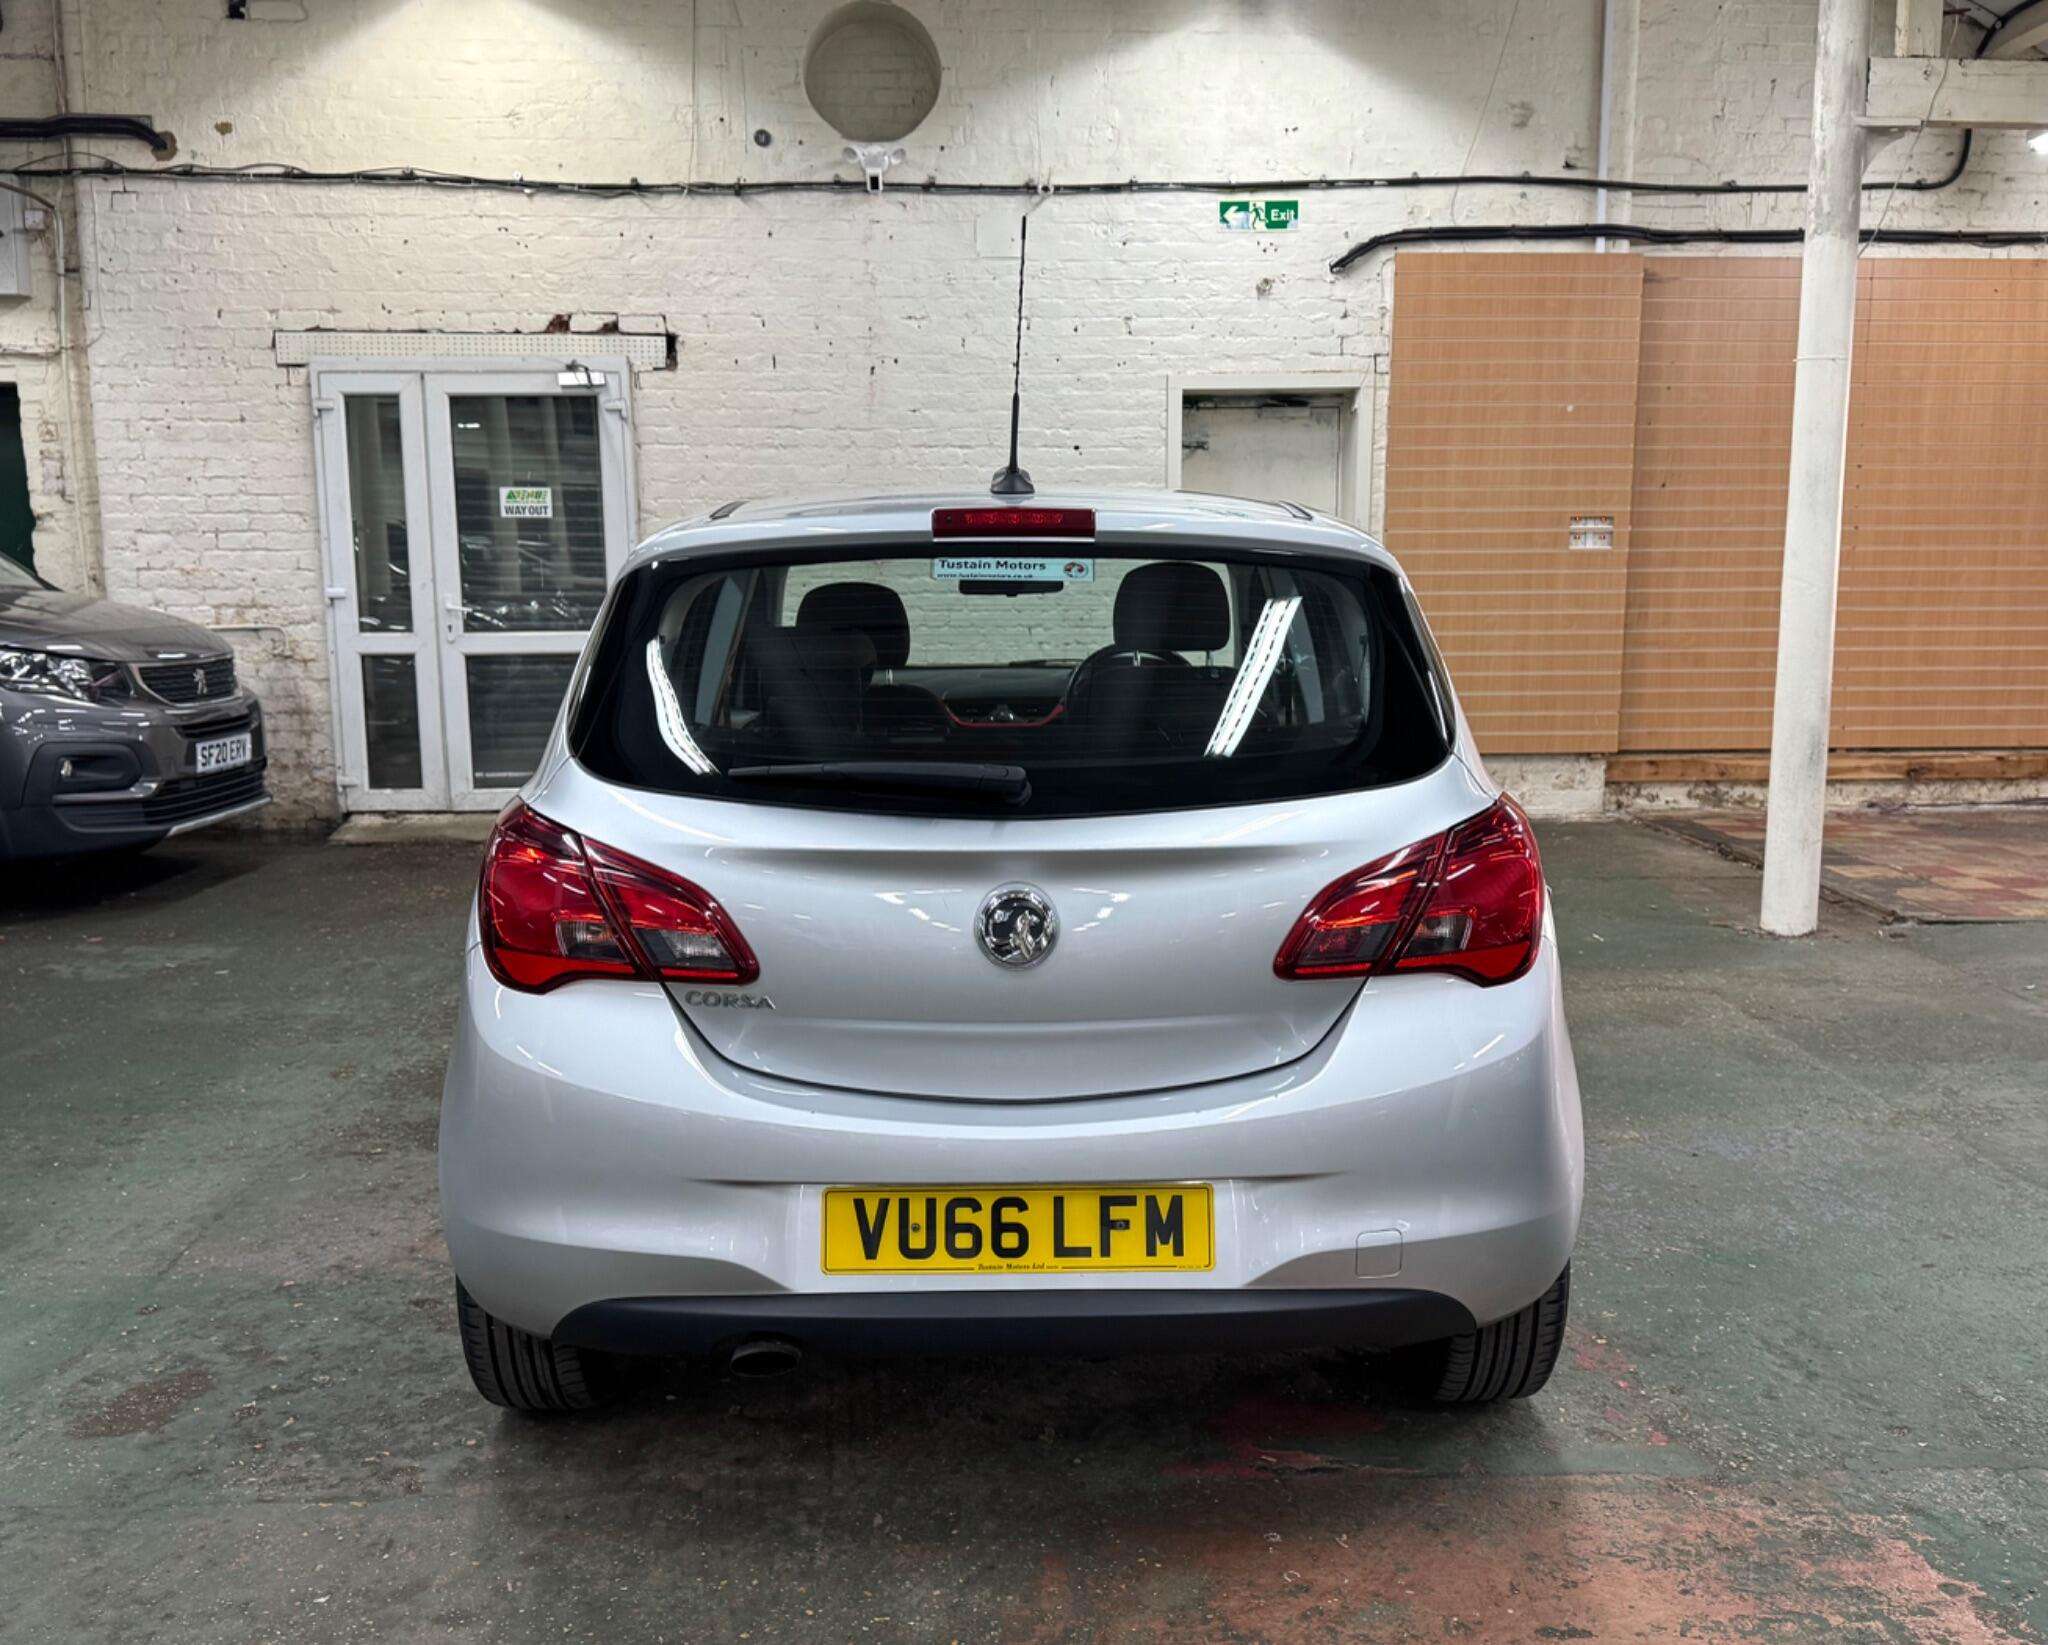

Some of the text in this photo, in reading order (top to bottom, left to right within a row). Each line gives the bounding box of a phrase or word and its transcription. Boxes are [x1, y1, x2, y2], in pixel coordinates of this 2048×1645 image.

[1271, 209, 1295, 221] Exit
[504, 505, 549, 515] WAY OUT
[938, 559, 1047, 570] Tustain Motors
[685, 990, 777, 1009] CORSA
[853, 1194, 1184, 1260] VU66 LFM
